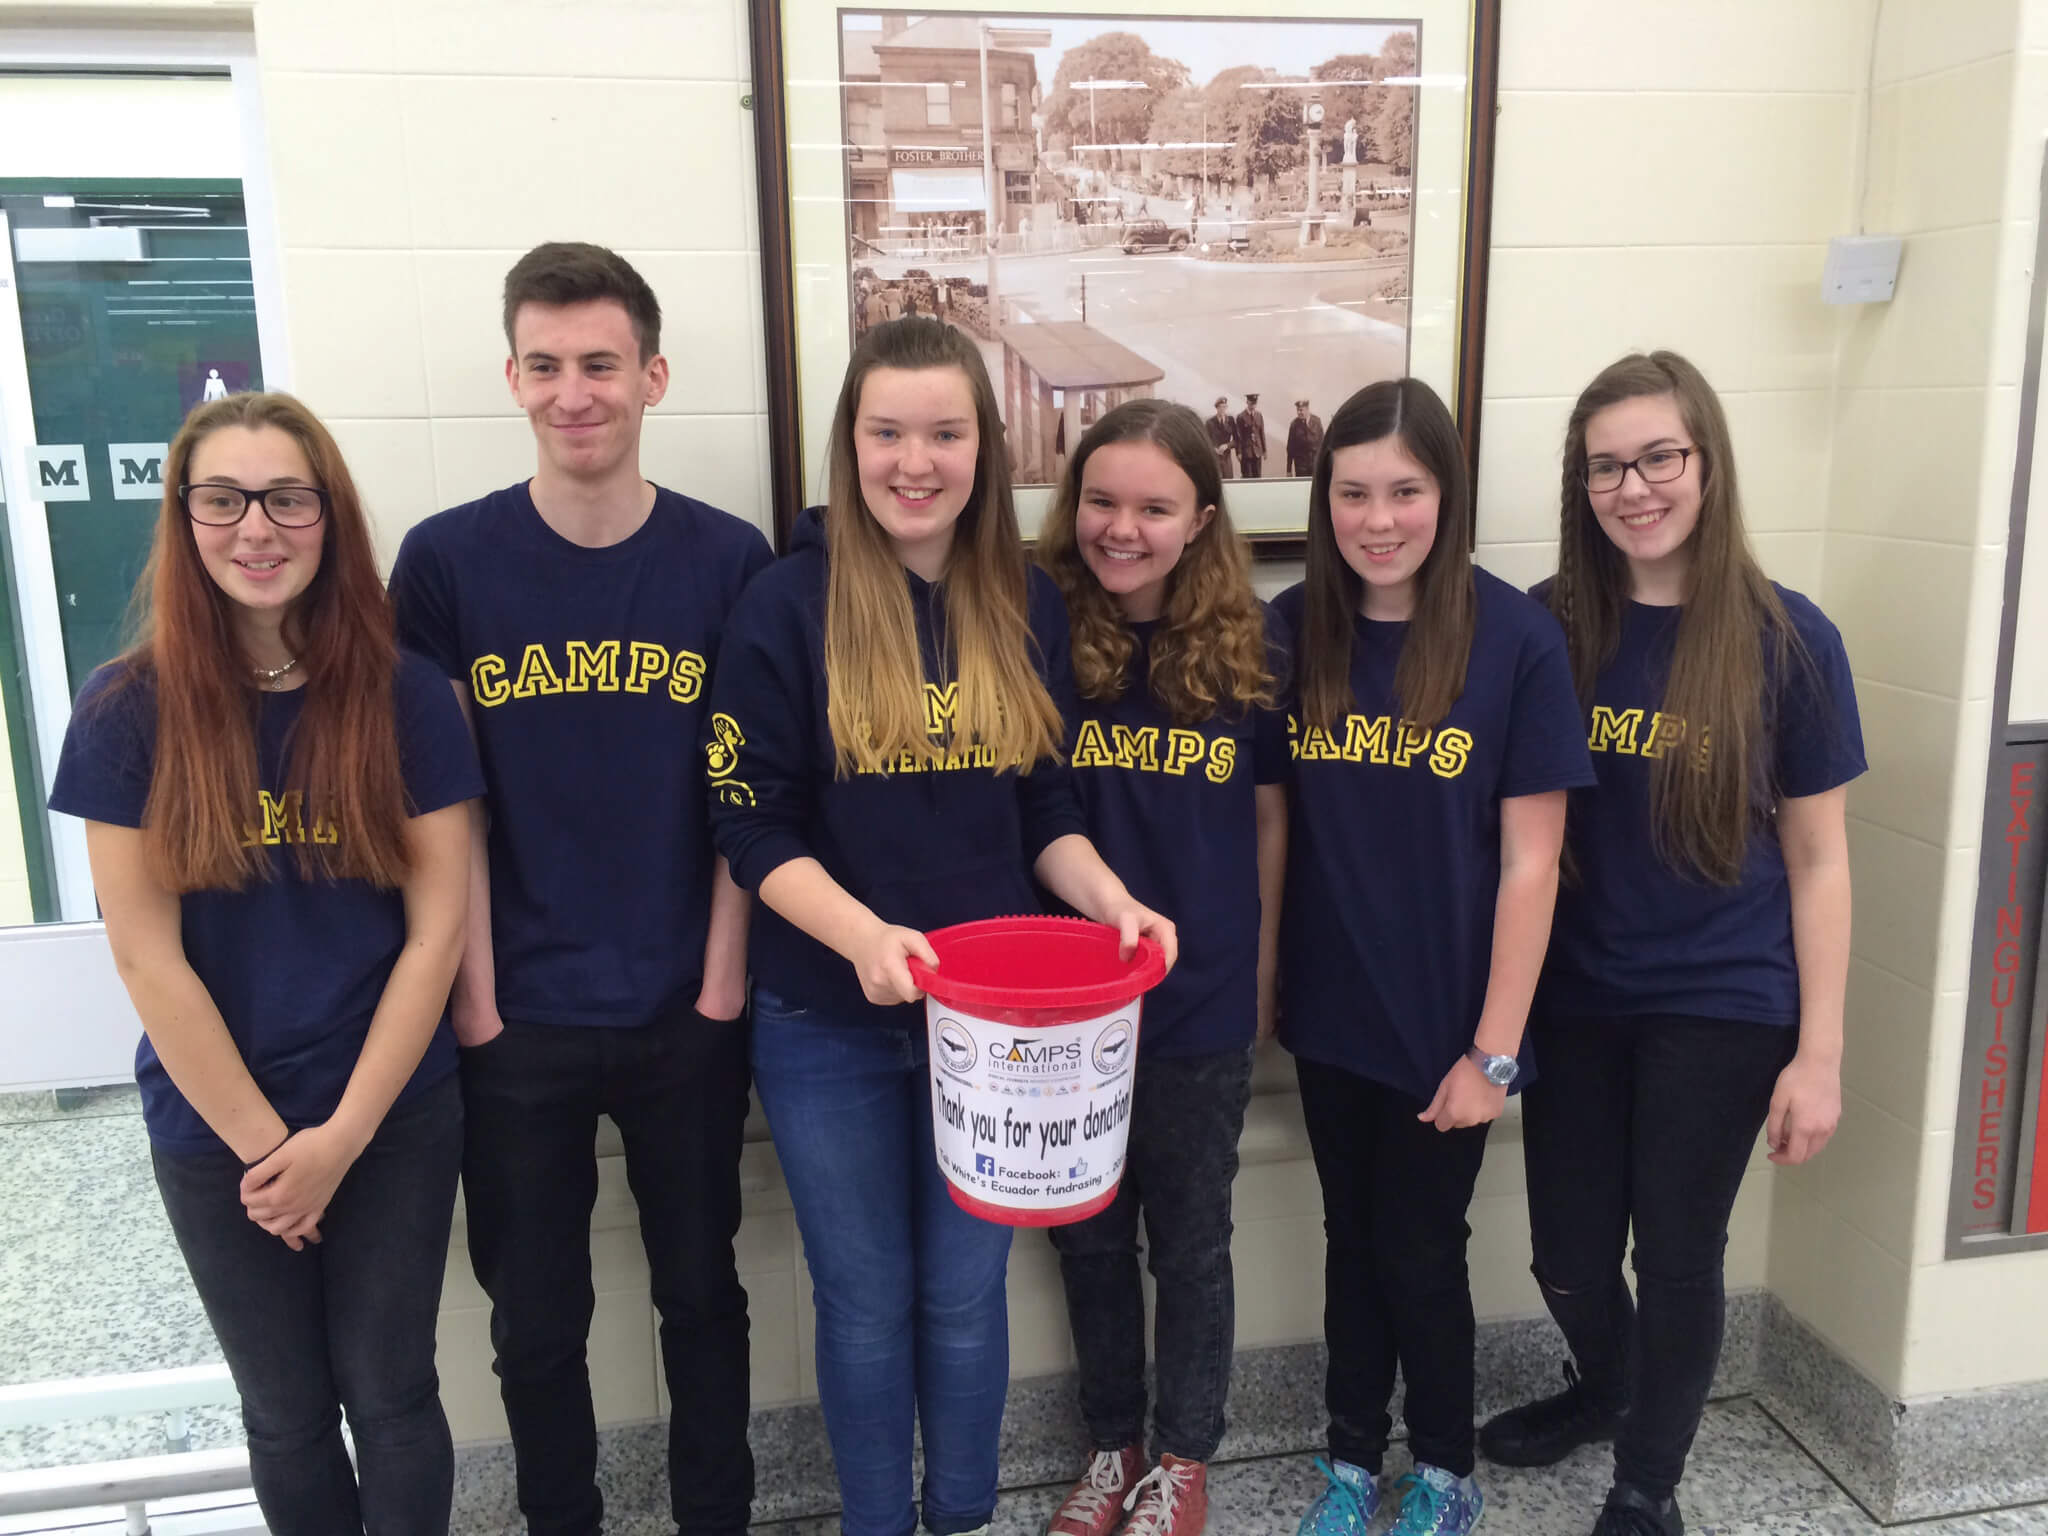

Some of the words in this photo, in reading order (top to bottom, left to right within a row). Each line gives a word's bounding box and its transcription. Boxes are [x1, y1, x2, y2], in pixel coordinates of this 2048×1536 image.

[895, 151, 934, 162] FOSTER
[939, 151, 985, 162] BROTHER
[38, 460, 80, 486] M
[119, 458, 164, 484] M
[471, 641, 707, 708] CAMPS
[1072, 720, 1237, 784] AMPS
[1973, 762, 2036, 1210] EXTINGUISHERS
[989, 1041, 1081, 1063] CAMPS
[988, 1059, 1082, 1074] international
[936, 1076, 966, 1132] Thank
[970, 1110, 996, 1148] you
[1003, 1106, 1032, 1148] for
[1039, 1117, 1077, 1160] your
[998, 1166, 1061, 1180] Facebook:
[991, 1180, 1040, 1196] Ecuador
